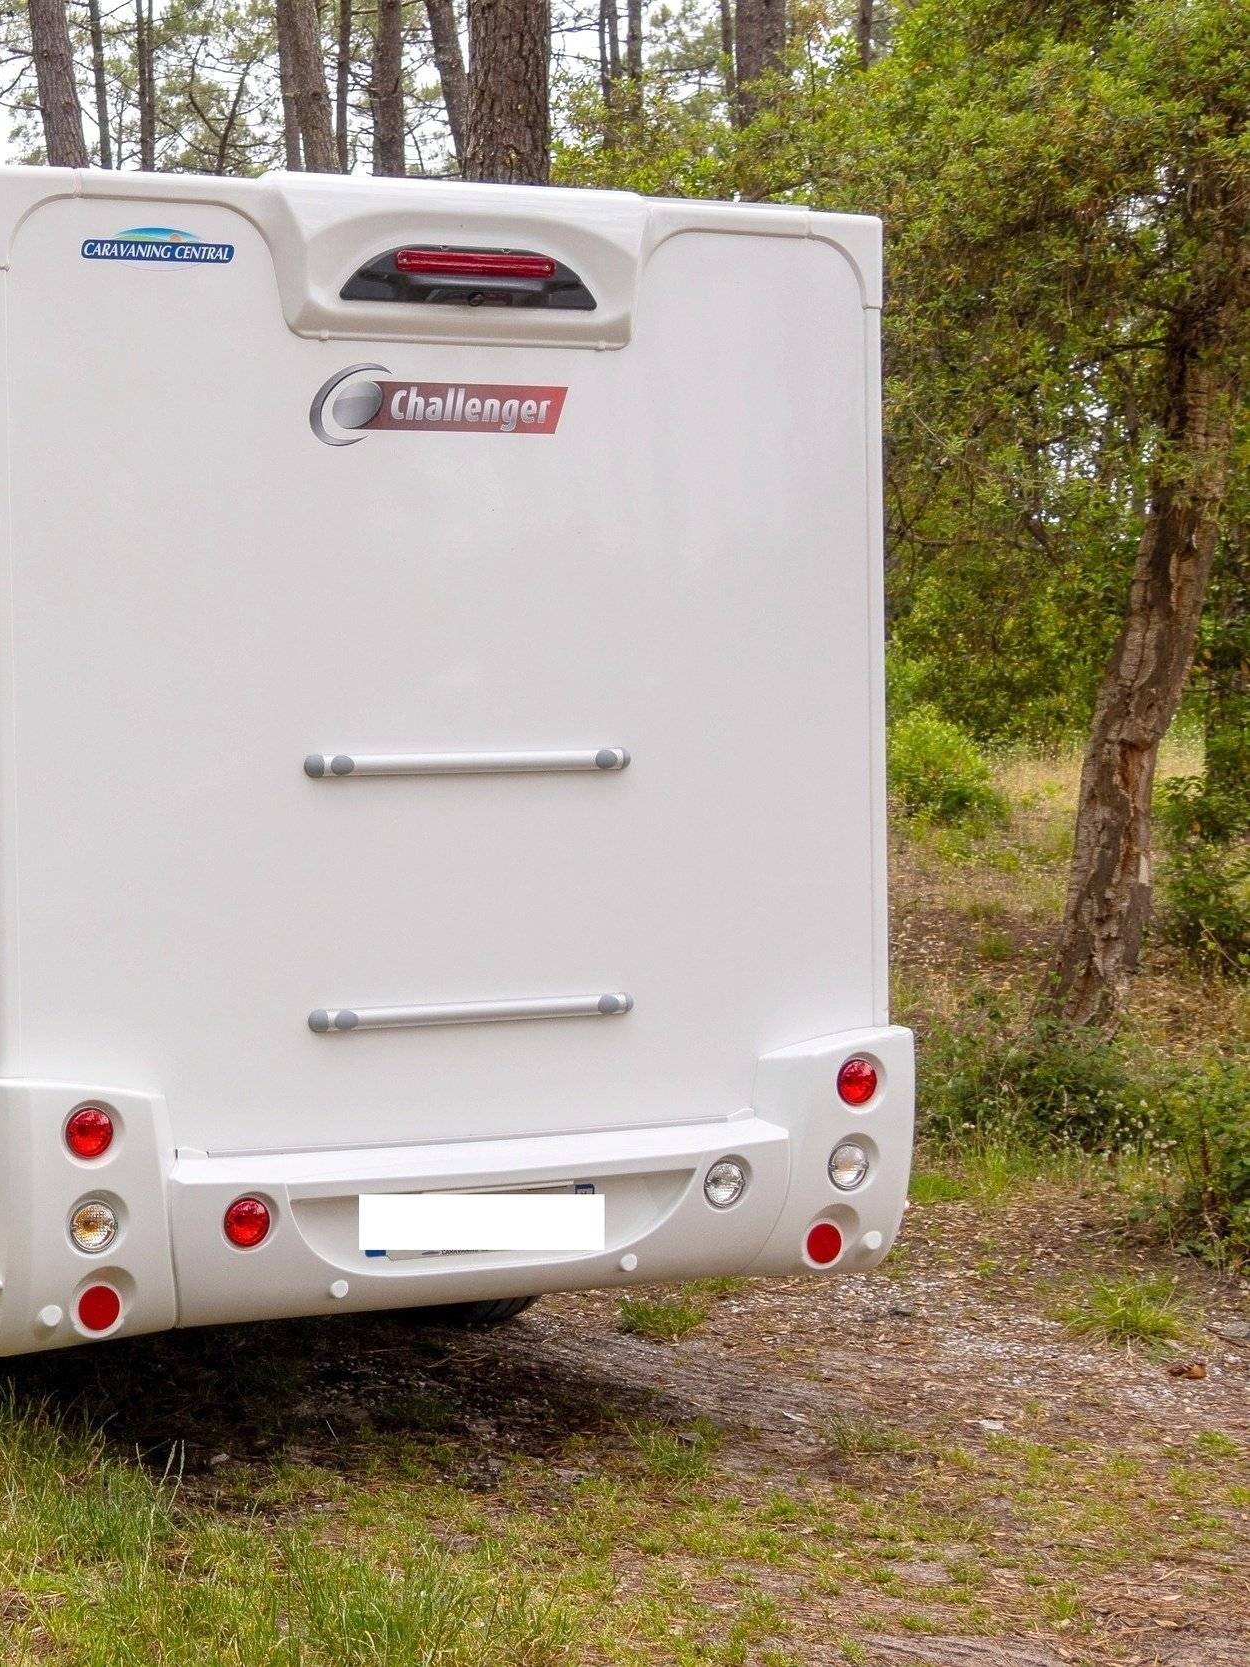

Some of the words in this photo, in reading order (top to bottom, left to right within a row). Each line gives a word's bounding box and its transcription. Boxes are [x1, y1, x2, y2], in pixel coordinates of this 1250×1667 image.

[83, 242, 172, 259] CARAVANING
[174, 245, 230, 261] CENTRAL
[390, 386, 552, 431] Challenger
